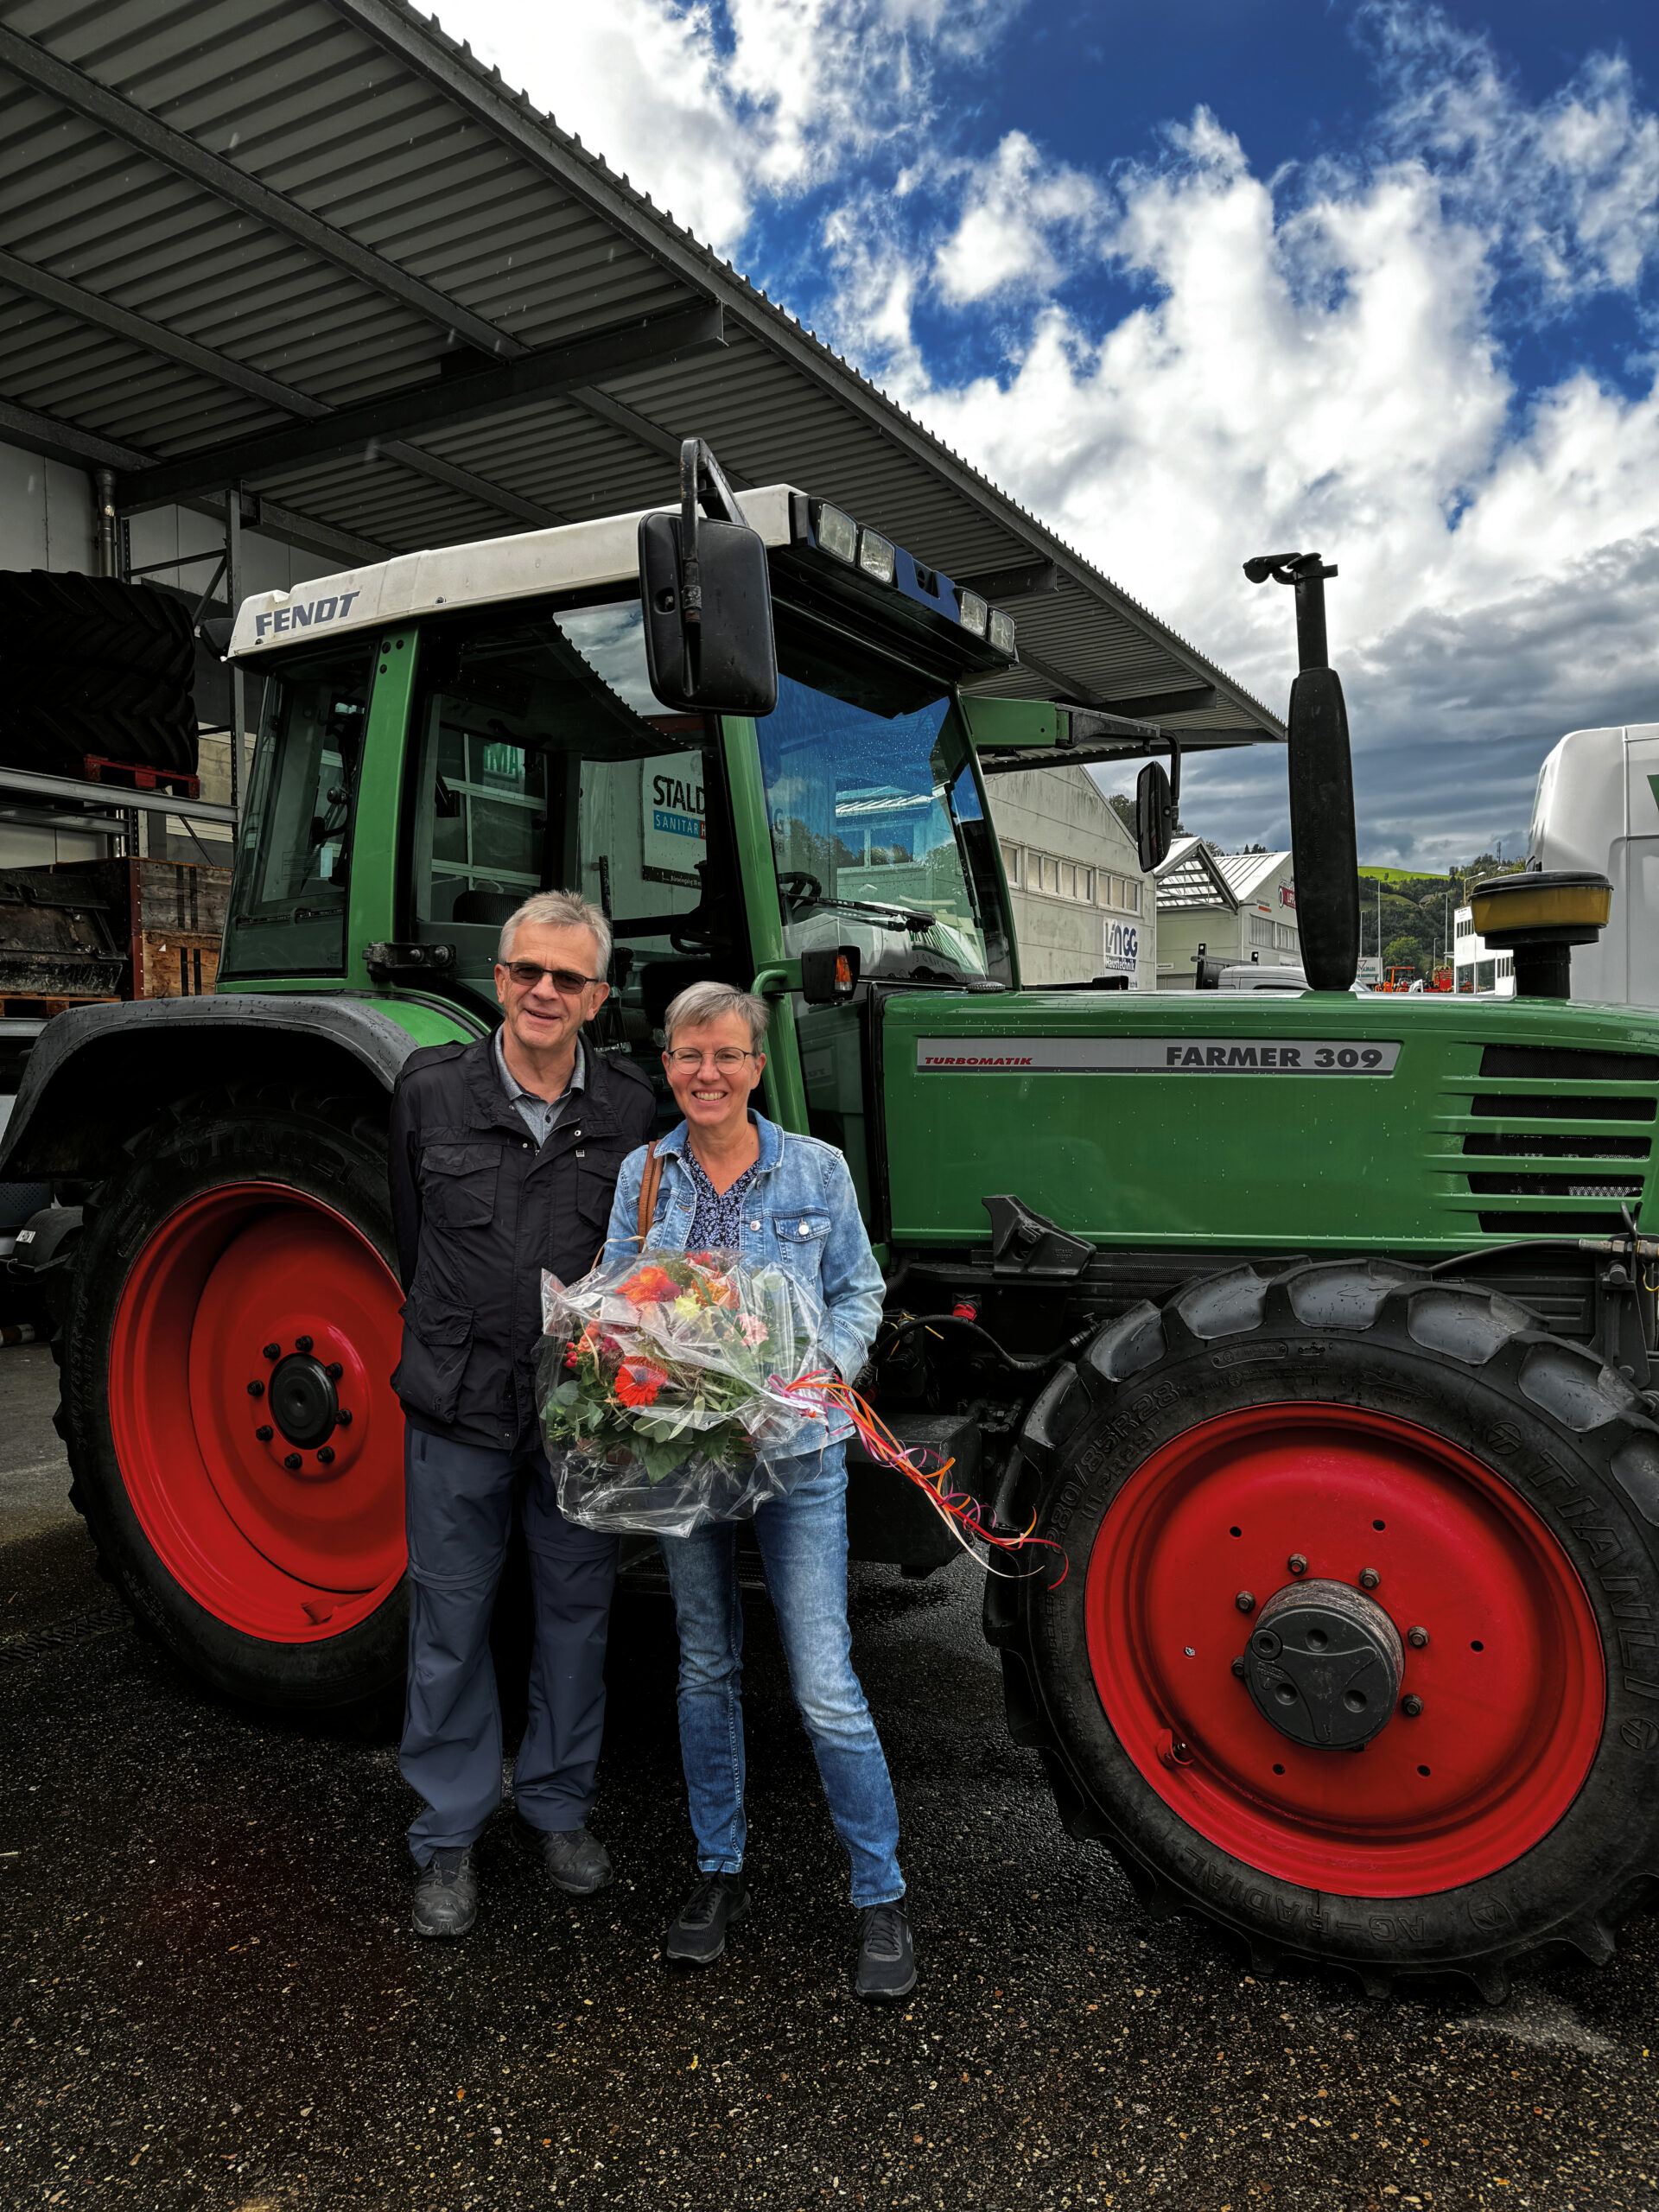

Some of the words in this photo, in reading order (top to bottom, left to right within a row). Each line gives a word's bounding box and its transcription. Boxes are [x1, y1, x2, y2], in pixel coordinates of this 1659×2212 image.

[255, 590, 360, 637] FENDT
[1105, 956, 1135, 972] Haustechnik
[925, 1057, 1033, 1065] TURBOMATIK
[1166, 1046, 1301, 1067] FARMER
[1313, 1047, 1383, 1068] 309
[1043, 1380, 1181, 1554] 280/85R28
[1527, 1448, 1658, 1700] TIANLI
[1185, 1846, 1426, 1942] AG-RADIAL
